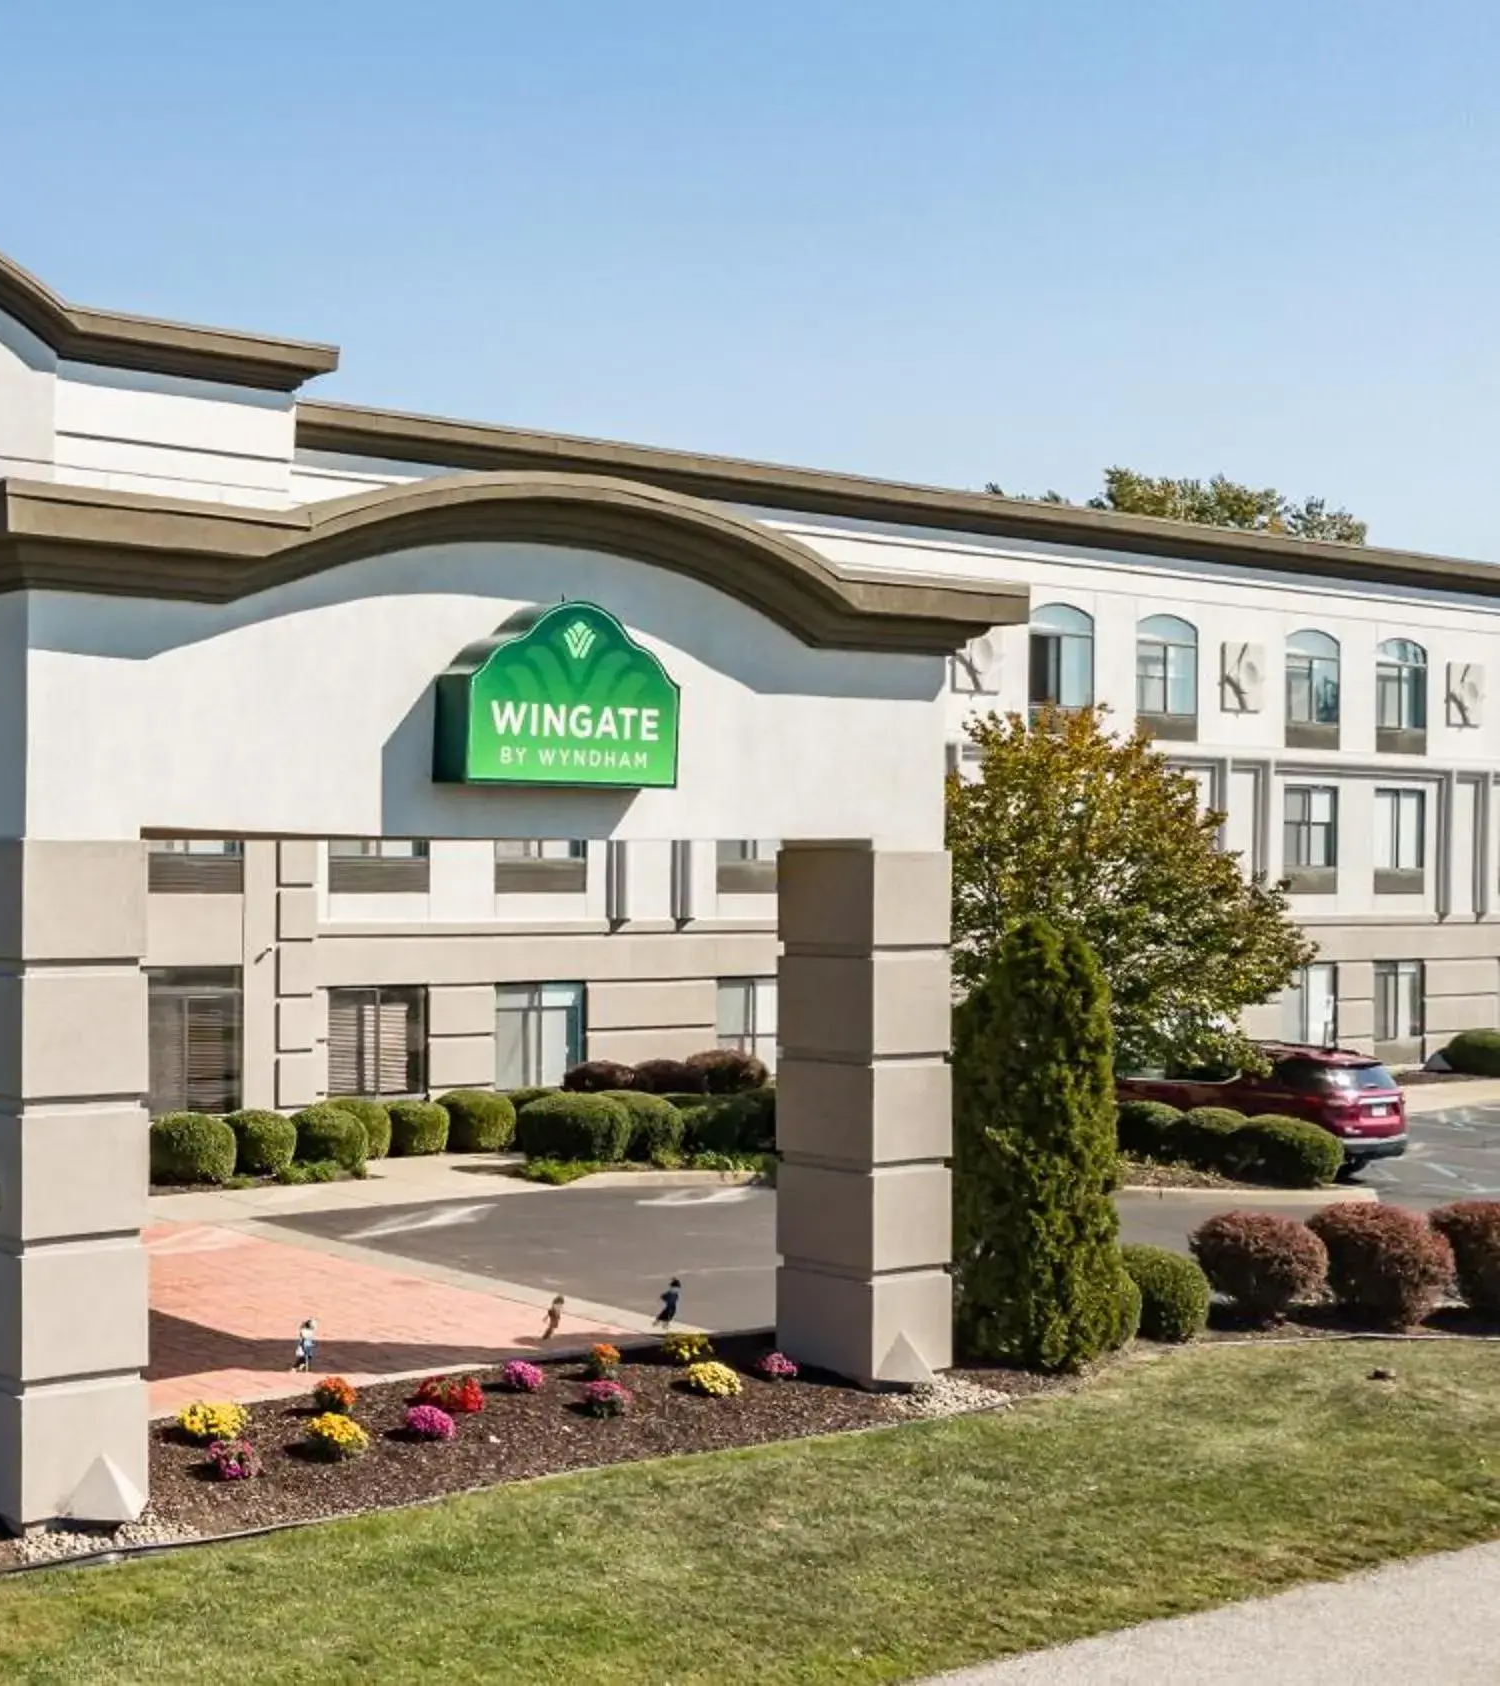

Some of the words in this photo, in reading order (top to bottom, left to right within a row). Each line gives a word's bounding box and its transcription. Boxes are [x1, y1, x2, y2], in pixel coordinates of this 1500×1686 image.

[491, 700, 660, 742] WINGATE
[500, 746, 527, 765] BY
[538, 749, 647, 768] WYNDHAM
